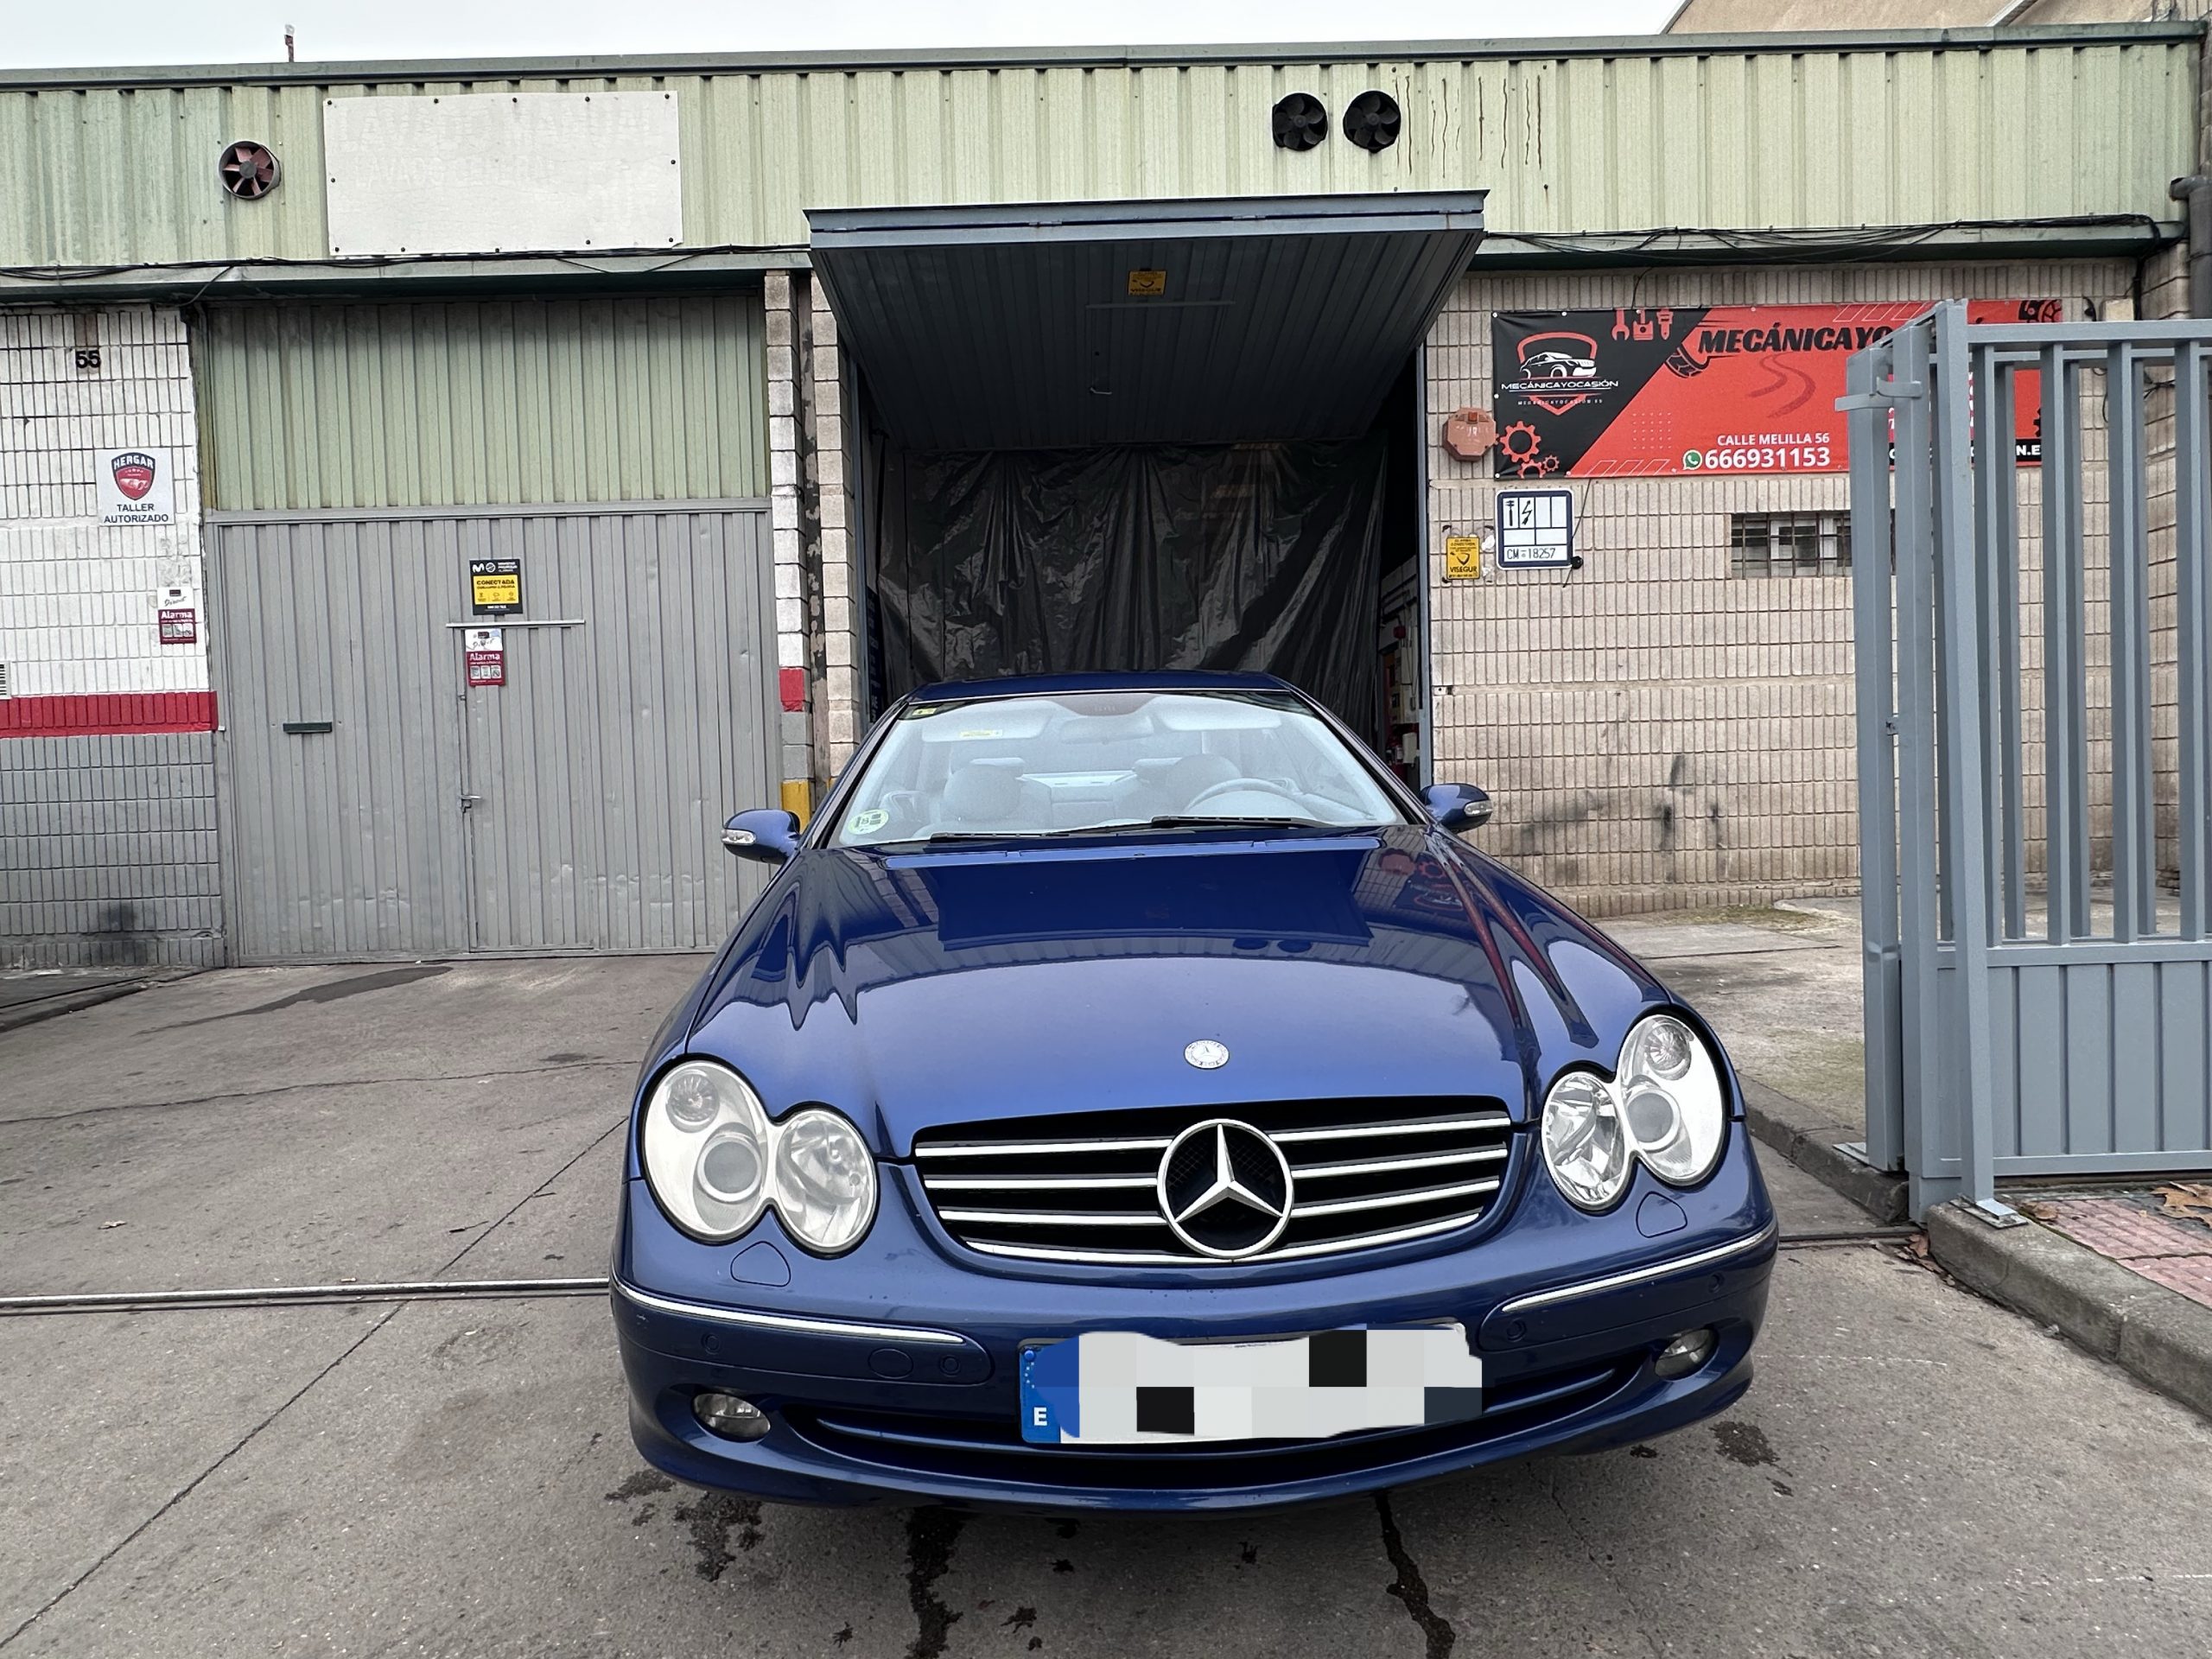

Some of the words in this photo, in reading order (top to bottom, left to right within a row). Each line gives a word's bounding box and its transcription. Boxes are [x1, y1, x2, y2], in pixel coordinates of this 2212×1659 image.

[75, 349, 101, 369] 55
[1501, 379, 1618, 390] MECÁNICAYOCASIÓN
[1717, 435, 1756, 446] CALLE
[1759, 433, 1812, 445] MELILLA
[1815, 432, 1830, 444] 56
[113, 454, 154, 470] HERGAR
[1705, 447, 1830, 469] 666931153
[116, 503, 155, 512] TALLER
[104, 513, 168, 524] AUTORIZADO
[161, 610, 193, 620] Alarma
[469, 652, 501, 663] Alarma
[1033, 1406, 1048, 1427] E
